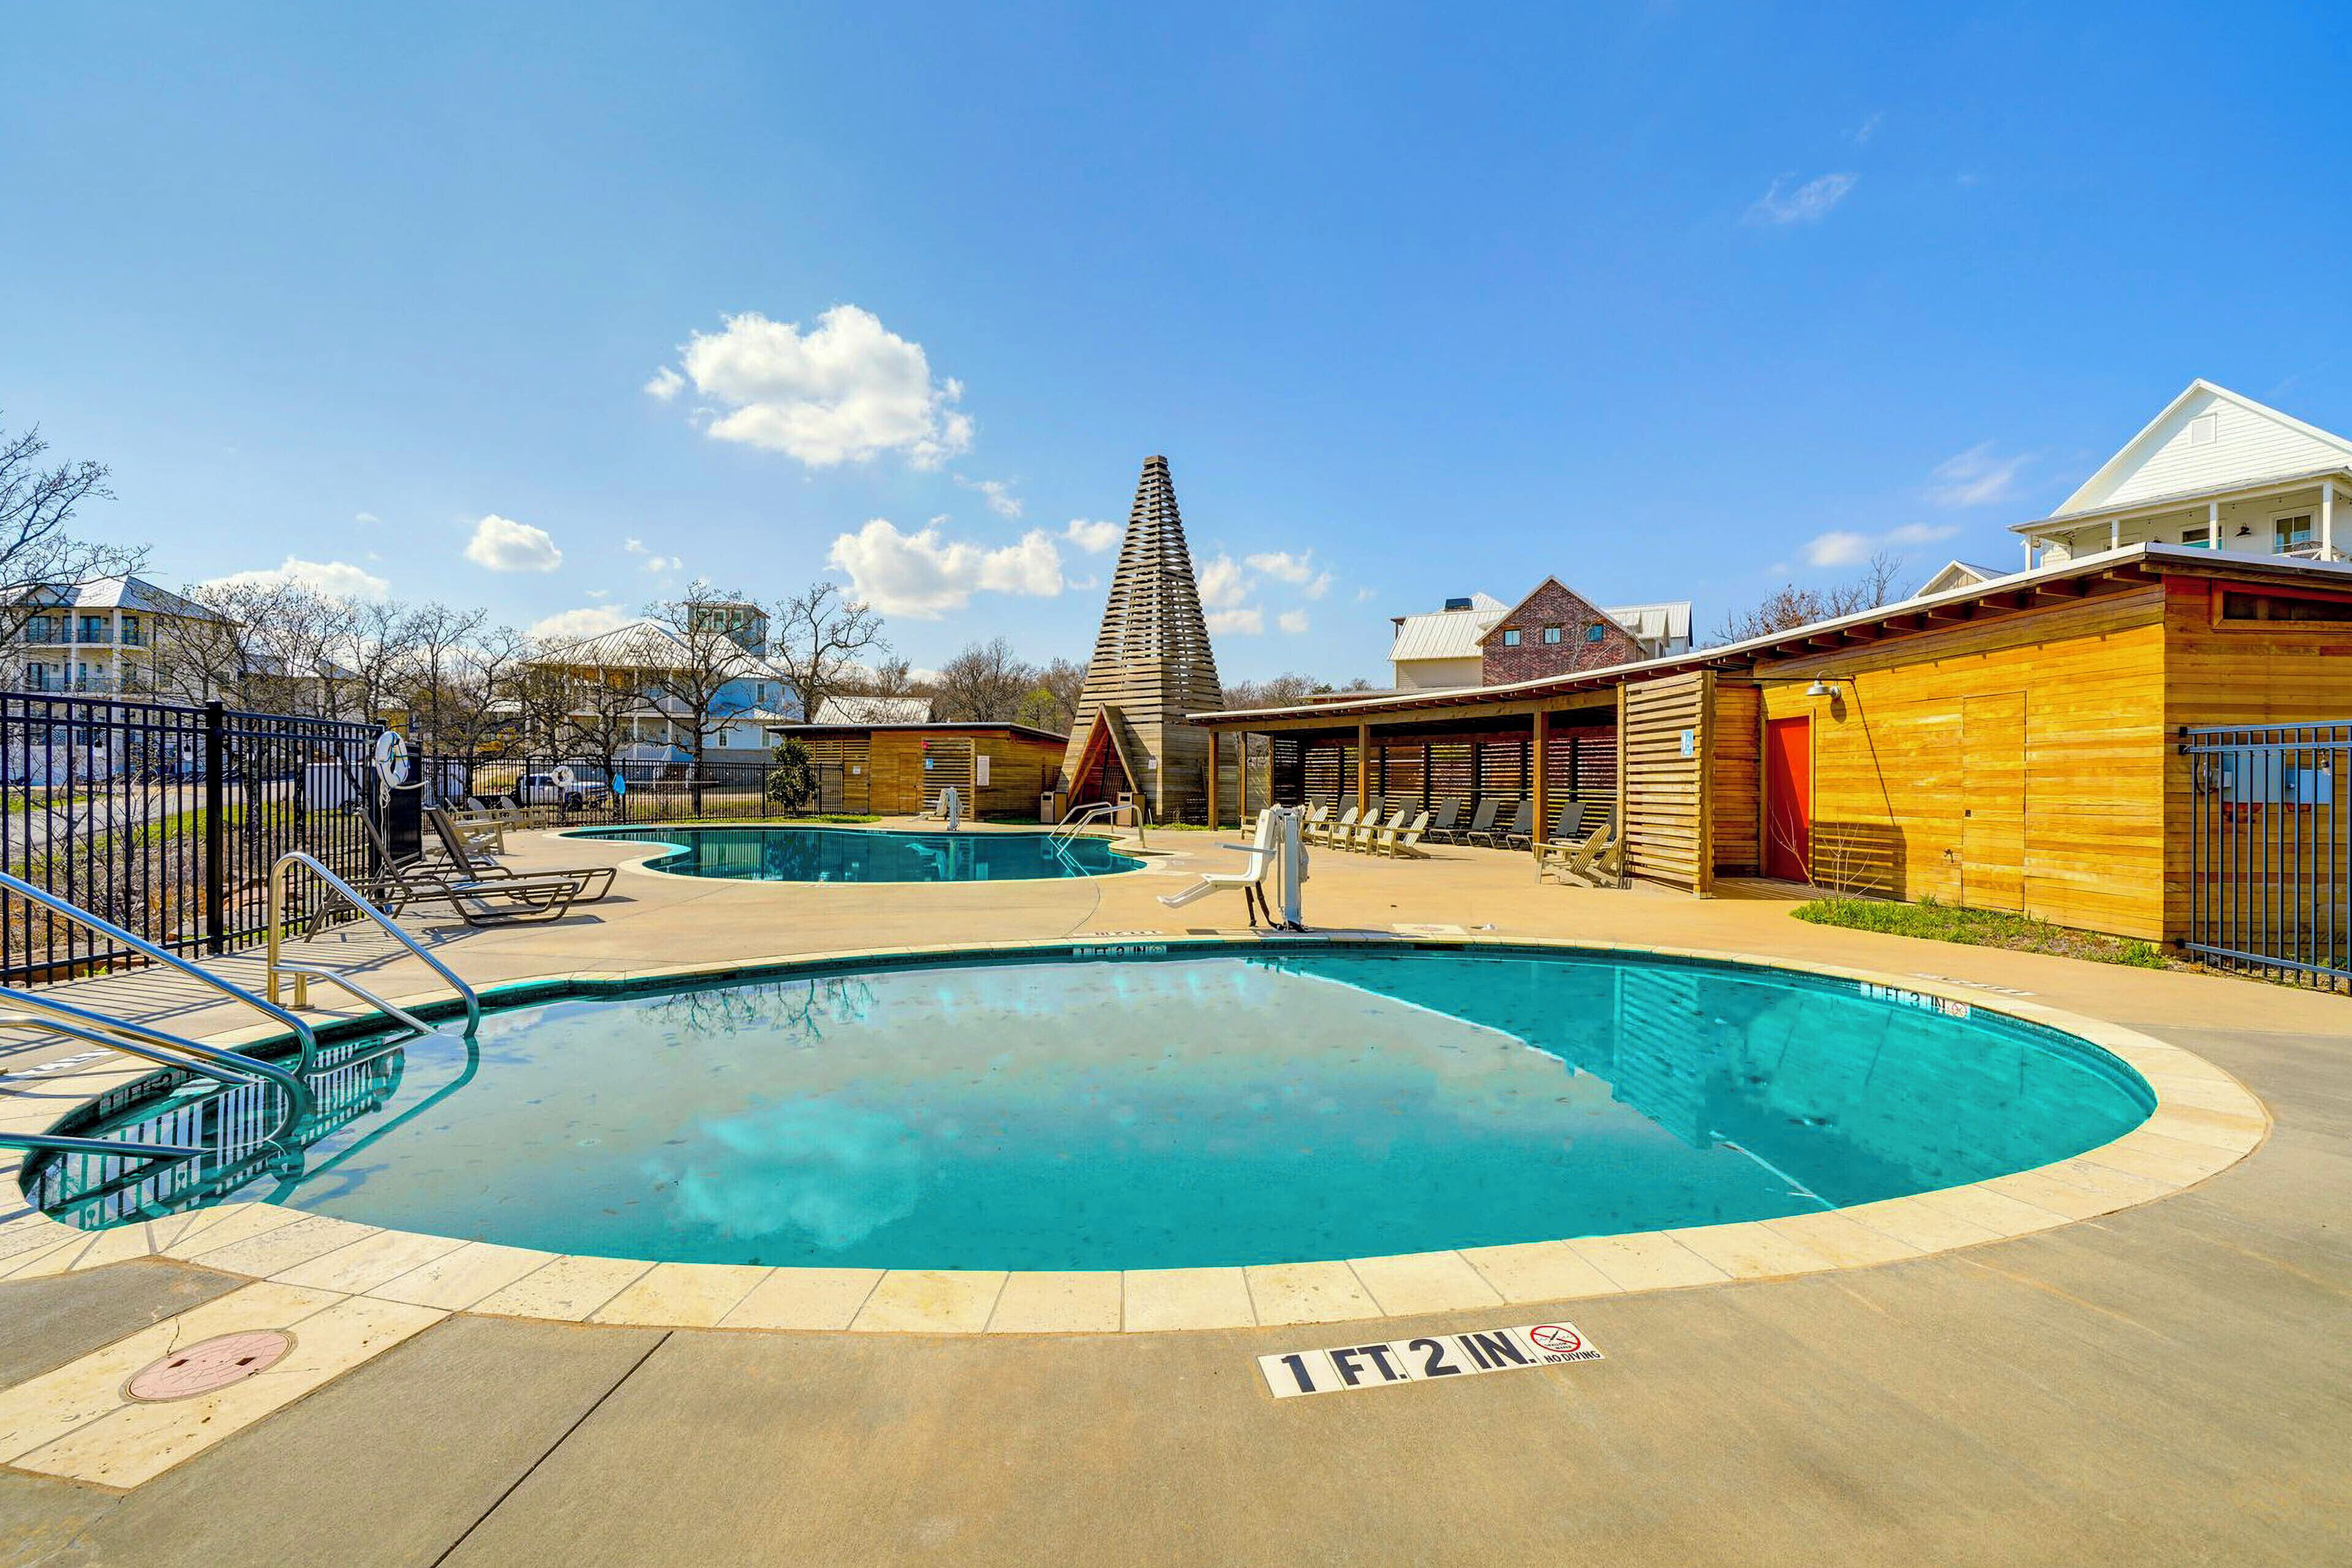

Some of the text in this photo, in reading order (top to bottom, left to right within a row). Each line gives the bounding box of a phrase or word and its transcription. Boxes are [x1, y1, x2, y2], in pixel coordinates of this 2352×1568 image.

[1281, 1331, 1537, 1393] 1 FT. 2 IN.
[1544, 1350, 1600, 1363] NO DIVING
